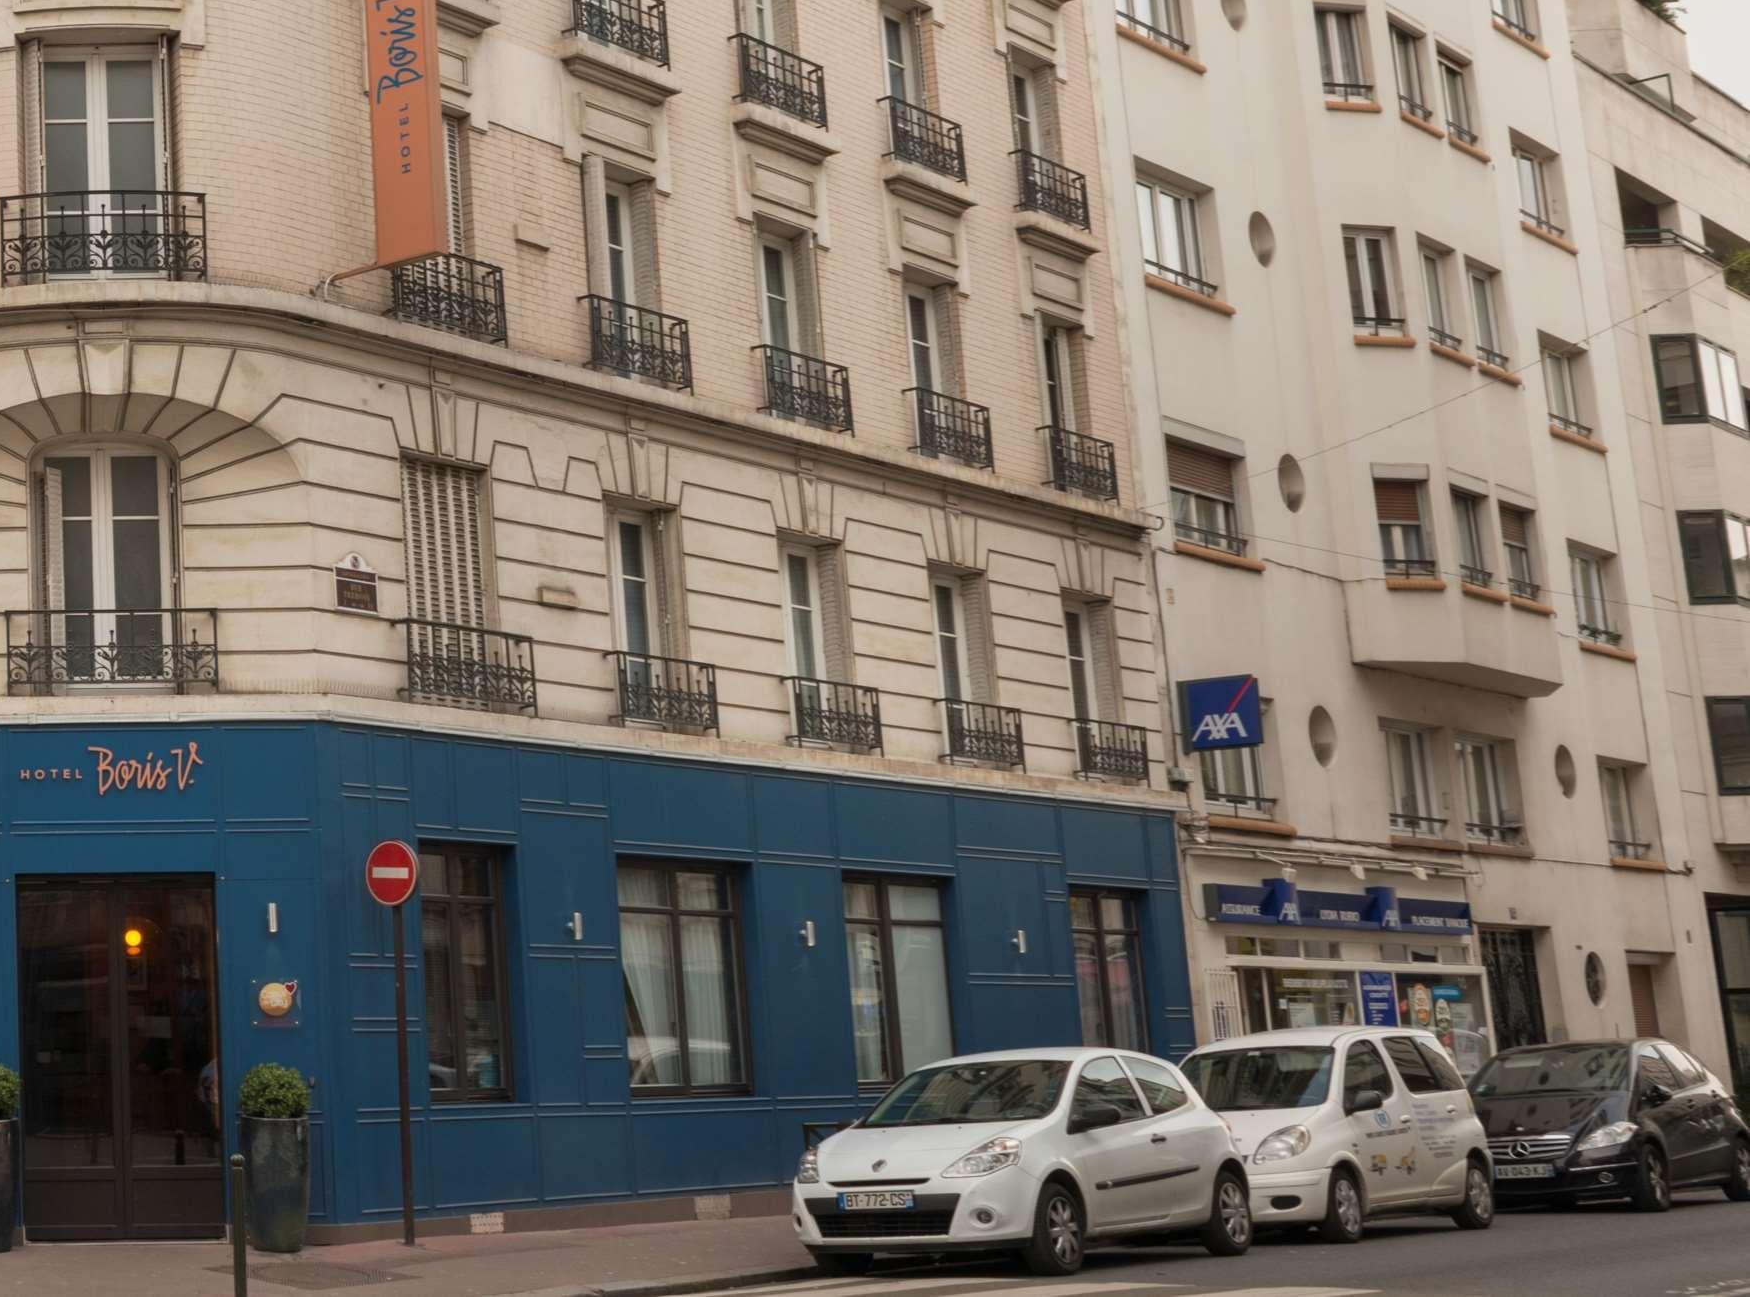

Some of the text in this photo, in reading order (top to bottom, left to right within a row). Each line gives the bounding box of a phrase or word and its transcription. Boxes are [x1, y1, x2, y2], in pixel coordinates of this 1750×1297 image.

[376, 4, 424, 104] Boris
[399, 102, 411, 174] HOTEL
[1192, 712, 1248, 742] AXA
[20, 768, 83, 780] HOTEL
[87, 745, 173, 795] Boris
